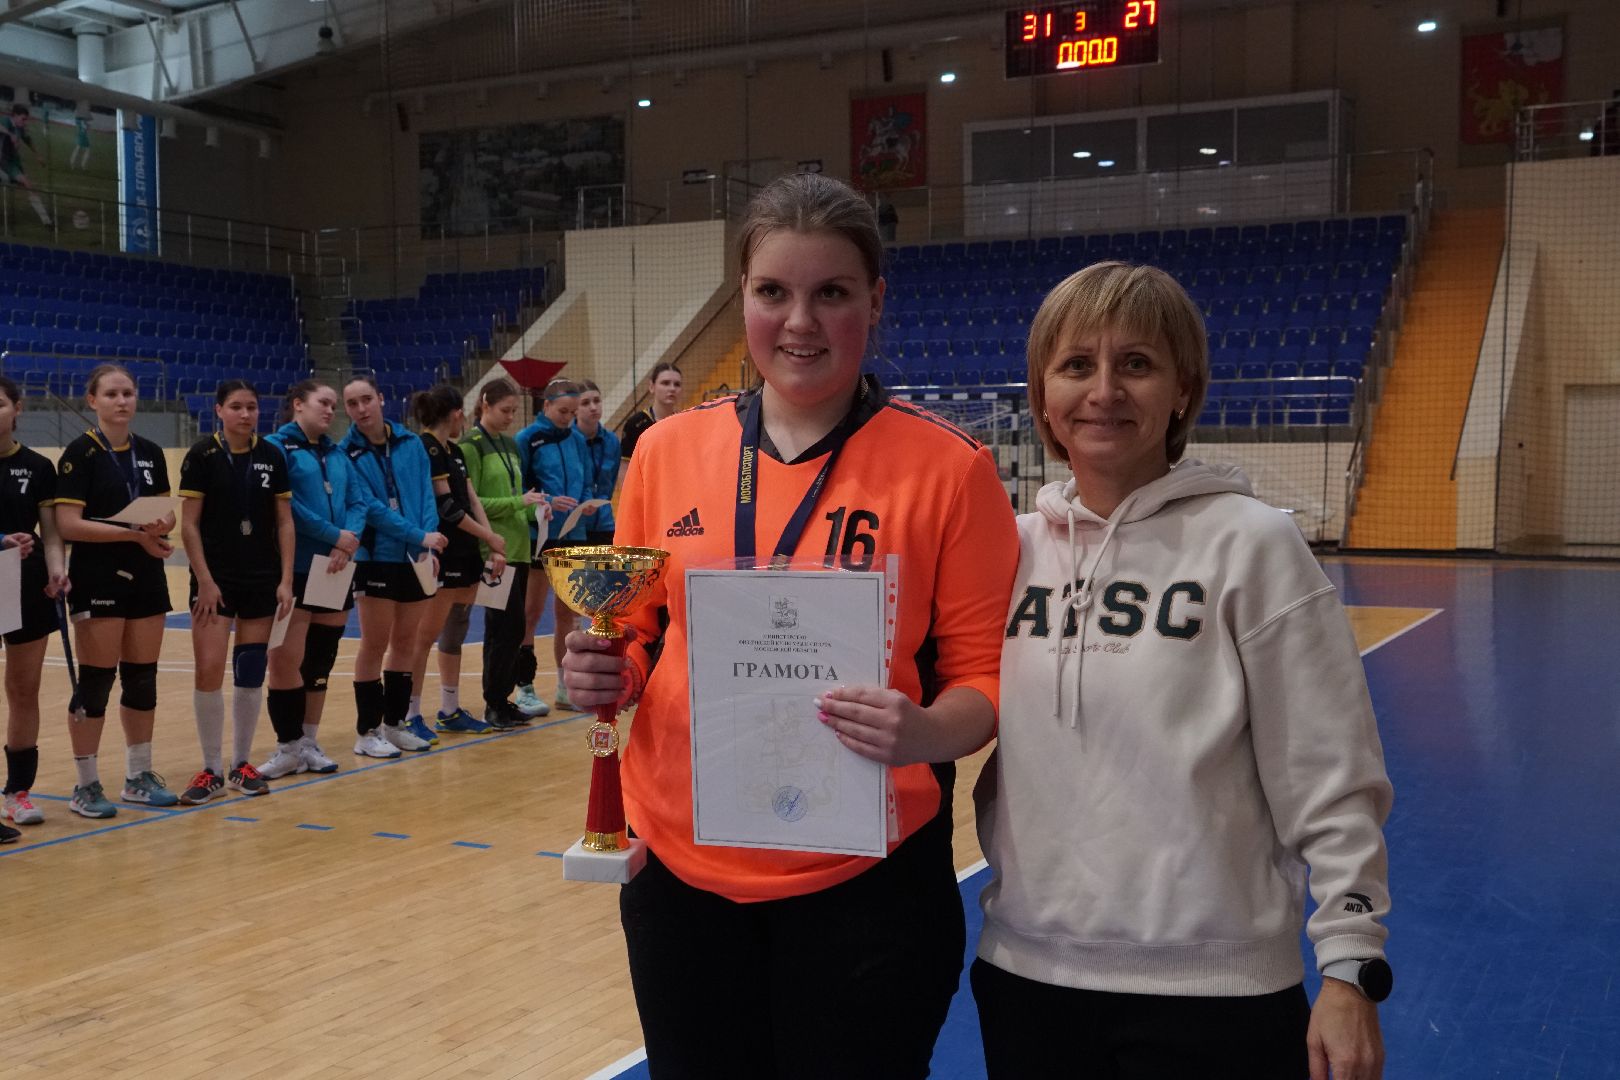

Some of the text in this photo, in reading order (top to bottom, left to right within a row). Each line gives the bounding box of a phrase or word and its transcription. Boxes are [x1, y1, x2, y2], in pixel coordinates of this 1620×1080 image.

[1075, 11, 1087, 31] 3
[1125, 0, 1156, 28] 27
[1023, 12, 1052, 41] 31
[17, 478, 29, 494] 7
[143, 469, 153, 486] 9
[260, 472, 270, 488] 2
[666, 525, 705, 538] adidas
[823, 506, 880, 572] 16
[732, 662, 839, 681] ГРАМОТА
[1344, 902, 1363, 913] ANTA
